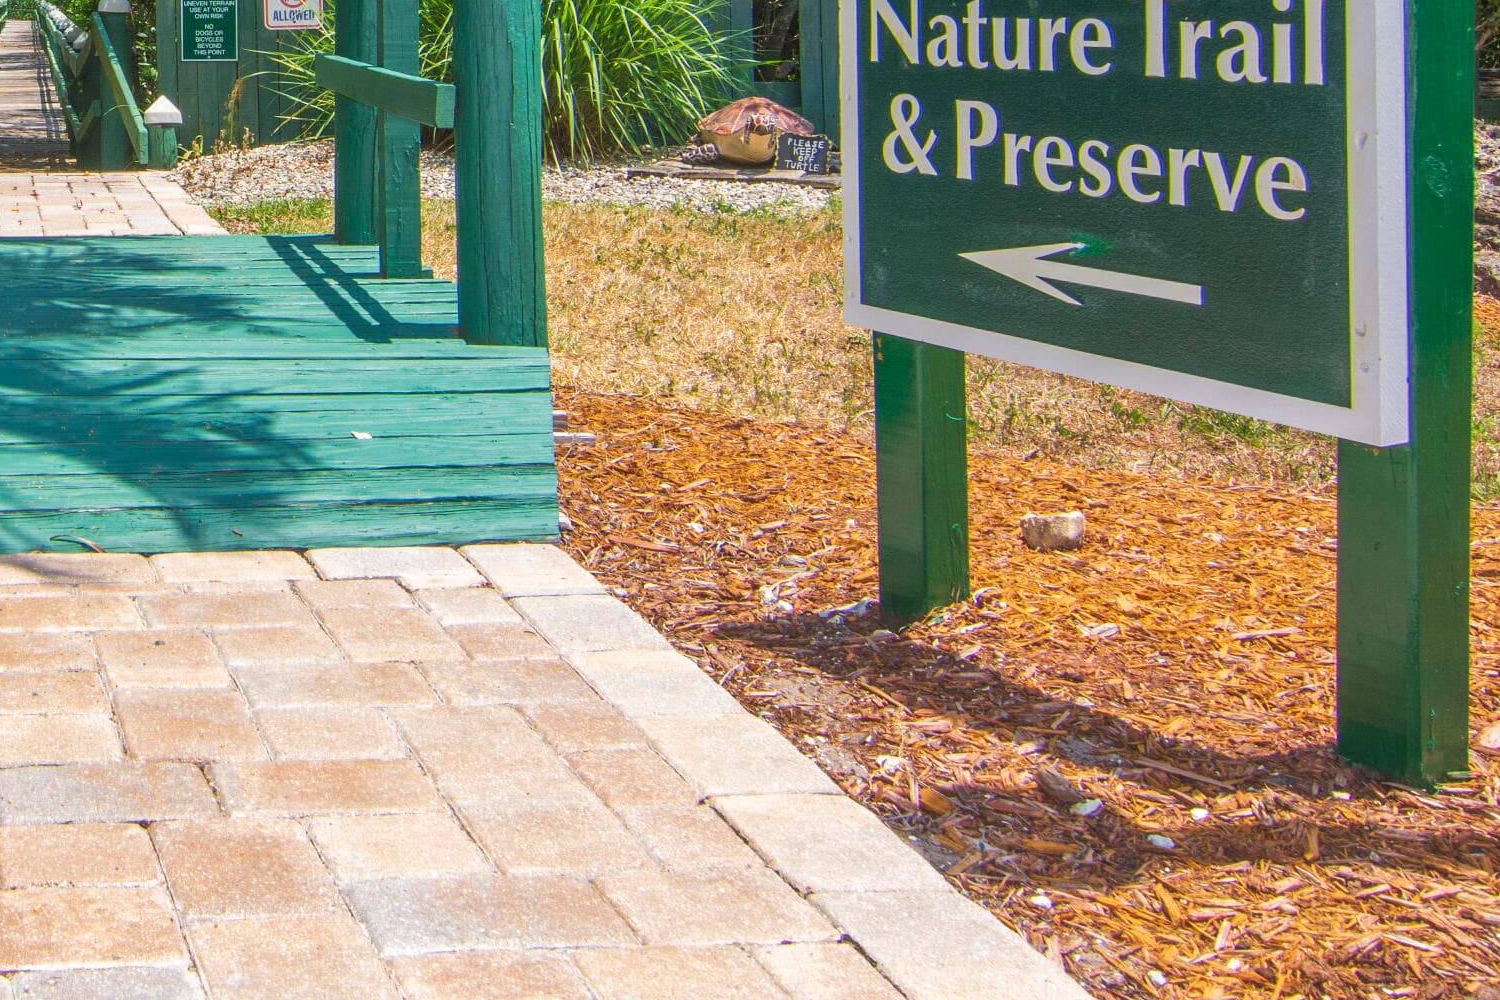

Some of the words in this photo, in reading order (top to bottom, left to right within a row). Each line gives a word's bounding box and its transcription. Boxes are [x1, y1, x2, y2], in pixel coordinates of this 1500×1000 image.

[787, 138, 825, 149] PLEASE
[793, 147, 818, 156] KEEP
[882, 92, 938, 178] &
[955, 99, 1308, 221] Preserve
[784, 160, 820, 172] TURTLE
